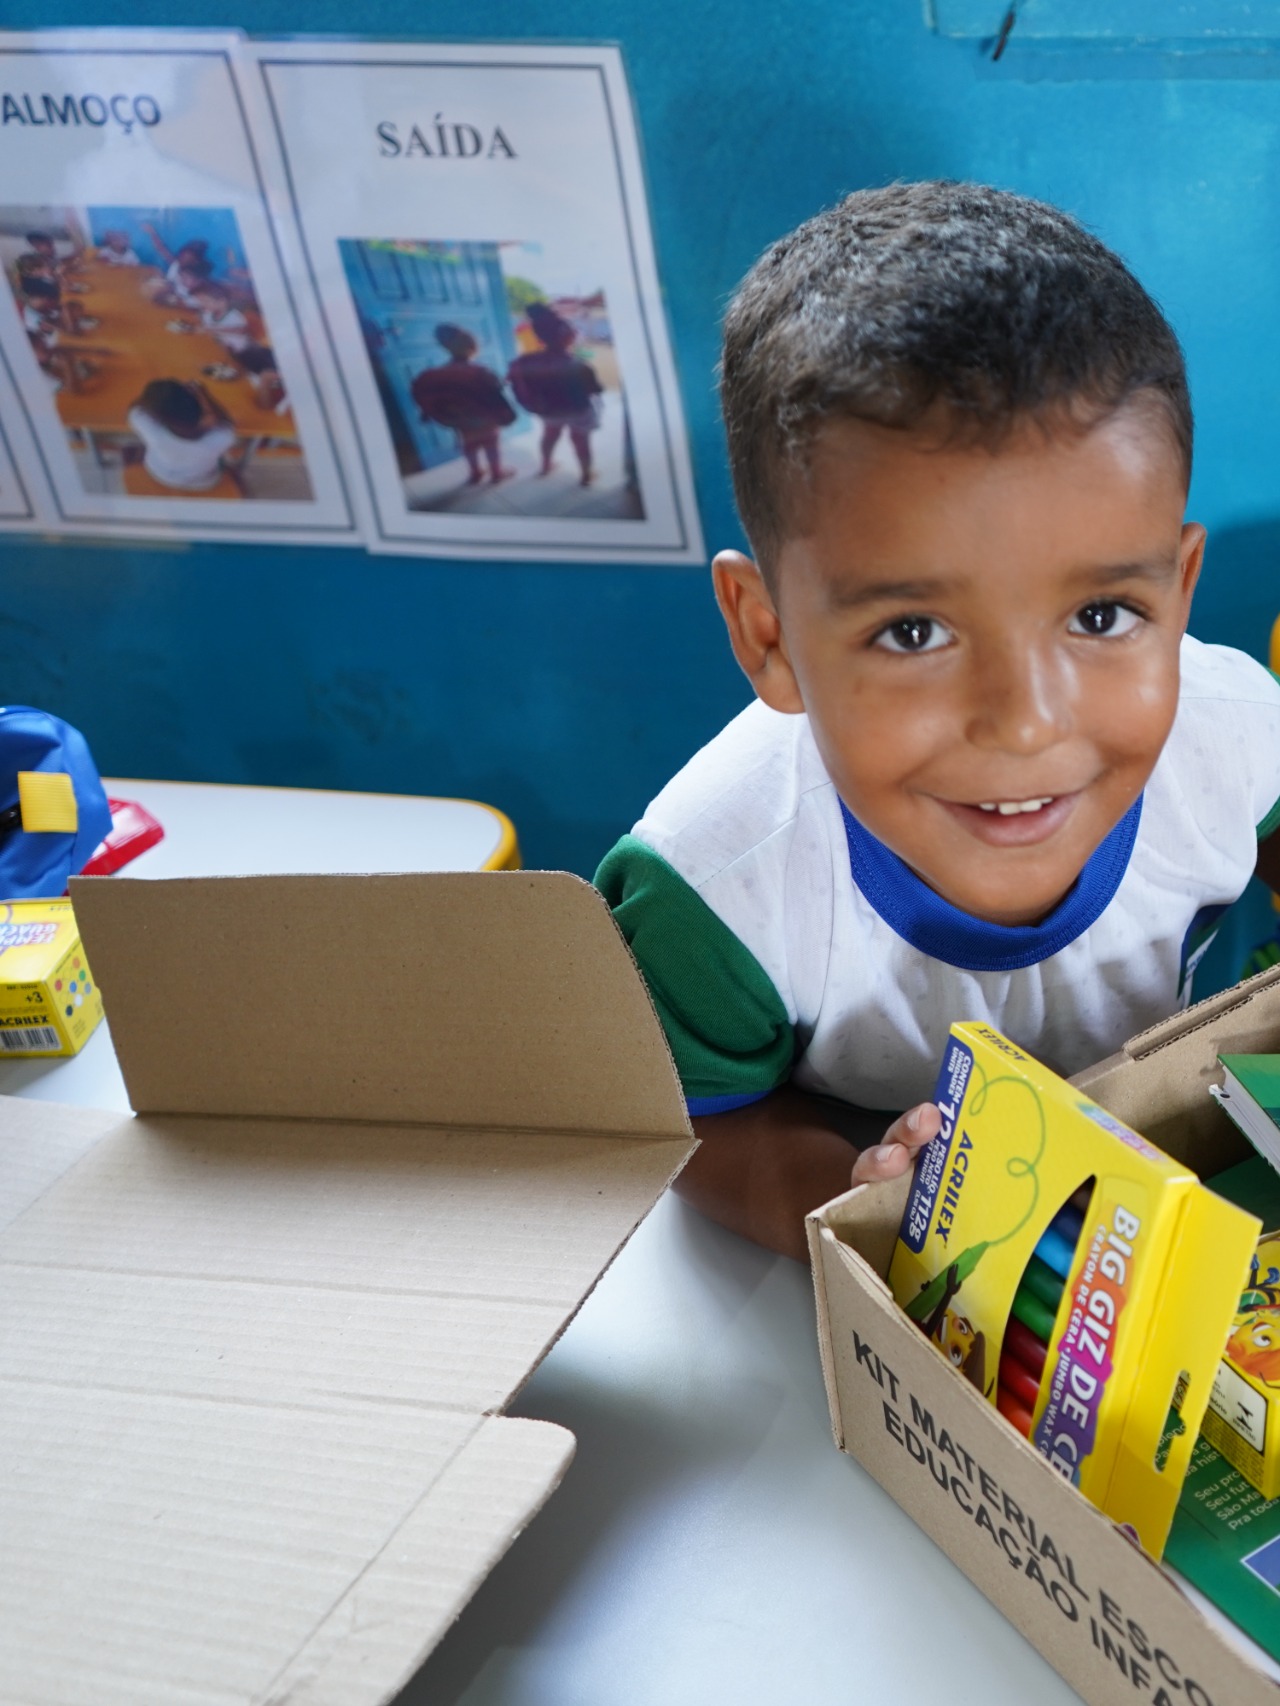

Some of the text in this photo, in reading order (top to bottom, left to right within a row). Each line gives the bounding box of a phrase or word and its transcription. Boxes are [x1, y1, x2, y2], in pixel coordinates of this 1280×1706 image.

[1, 92, 162, 134] ALMOÇO
[376, 112, 517, 159] SAÍDA
[947, 1046, 960, 1074] UNITS
[976, 1027, 1030, 1063] ACRILEX
[947, 1050, 965, 1096] UNIDADES
[952, 1055, 972, 1104] CONTÉM
[919, 1152, 932, 1185] WEIGHT
[930, 1138, 941, 1162] PESO
[933, 1143, 947, 1175] PESO
[925, 1161, 935, 1186] NETO
[935, 1128, 974, 1243] ACRILEX
[909, 1194, 932, 1243] 112g
[1083, 1223, 1107, 1285] CRAYON
[1098, 1203, 1142, 1287] BIG
[1075, 1285, 1090, 1306] DE
[1064, 1307, 1084, 1346] CERA
[1077, 1289, 1116, 1367] GIZ
[1051, 1350, 1072, 1402] JUMBO
[1061, 1362, 1098, 1430] DE
[1042, 1403, 1059, 1441] WAX
[851, 1328, 900, 1405] KIT
[908, 1392, 1091, 1603] MATERIAL
[881, 1399, 1080, 1624] EDUCAÇÃO
[1193, 1482, 1221, 1501] Seu
[1204, 1493, 1233, 1512] Seu
[1216, 1502, 1243, 1522] São
[1226, 1514, 1252, 1532] Pra
